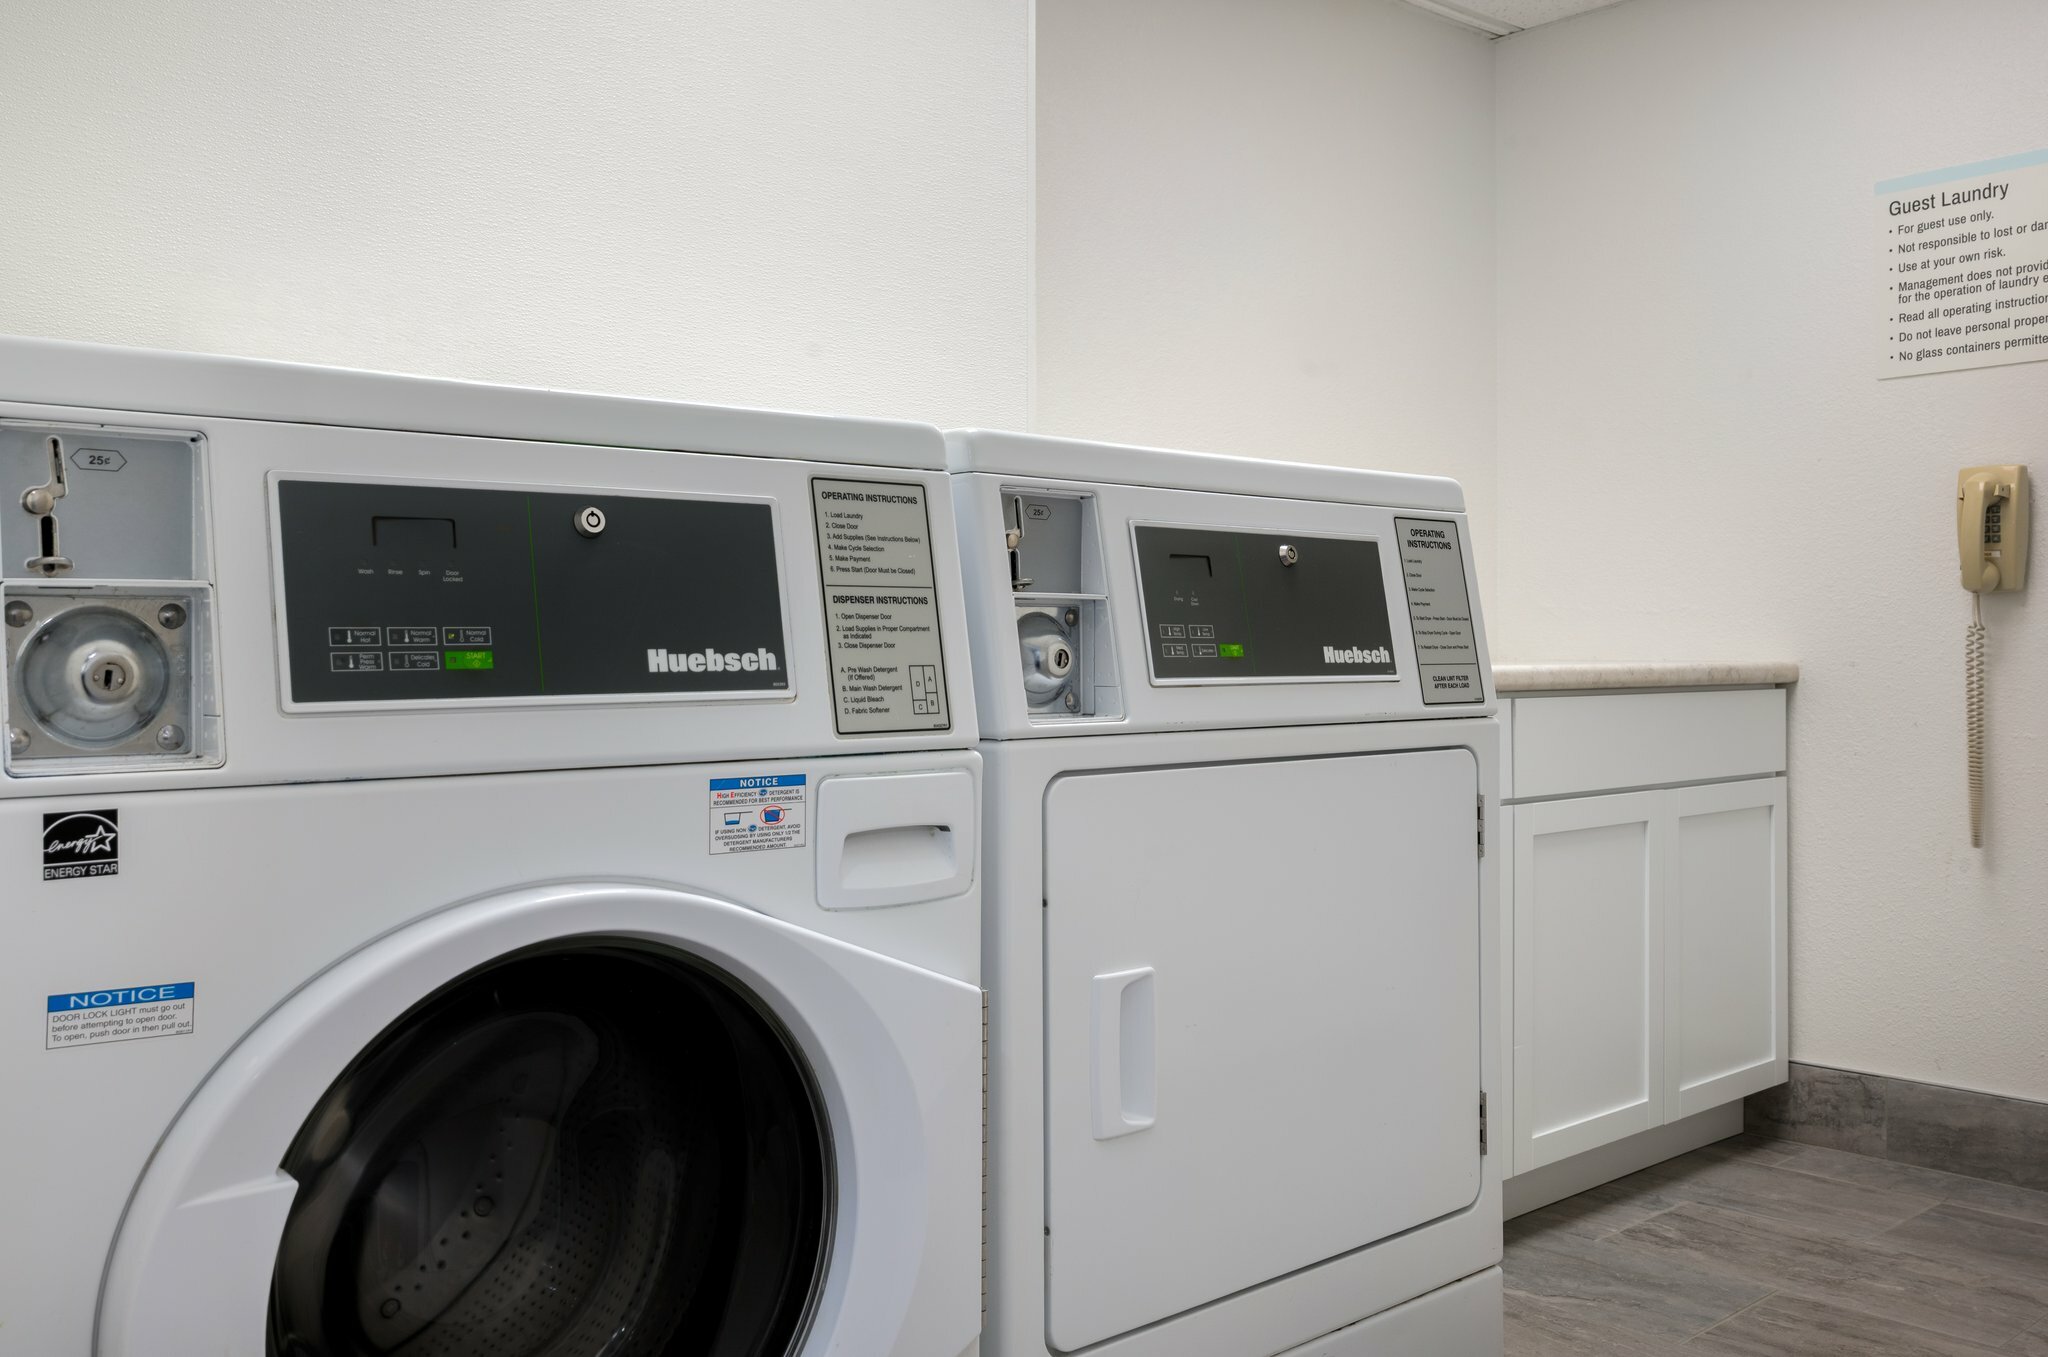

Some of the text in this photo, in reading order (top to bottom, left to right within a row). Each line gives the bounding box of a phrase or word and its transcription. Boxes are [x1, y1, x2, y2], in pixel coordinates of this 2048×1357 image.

[1889, 183, 2009, 215] Guest Laundry
[1898, 210, 1994, 234] For guest use only.
[1899, 225, 2027, 253] Not responsible to lost or
[1899, 247, 2006, 272] Use at your own risk.
[1899, 274, 1963, 291] Management
[1967, 271, 1992, 281] does
[1996, 266, 2012, 276] not
[1898, 274, 2039, 304] for the operation of laundry
[1899, 311, 1924, 322] Read
[1928, 308, 1939, 319] all
[1943, 302, 1992, 318] operating
[1899, 332, 1912, 342] Do
[1916, 329, 1931, 340] not
[1935, 327, 1961, 337] leave
[1966, 318, 2010, 335] personal
[1900, 351, 1912, 360] No
[1916, 348, 1942, 361] glass
[1946, 340, 2000, 355] containers
[89, 454, 111, 466] 25¢
[822, 491, 917, 504] OPERATING INSTRUCTIONS
[1410, 529, 1445, 538] OPERATING
[1407, 540, 1451, 550] INSTRUCTIONS
[833, 595, 928, 604] DISPENSER INSTRUCTIONS
[647, 648, 777, 673] Huebsch
[1323, 646, 1390, 663] Huebsch
[874, 666, 897, 674] Detergent
[740, 778, 778, 787] NOTICE
[45, 864, 117, 879] ENERGY STAR
[70, 986, 175, 1008] NOTICE
[53, 1014, 80, 1022] DOOR
[83, 1011, 108, 1020] LOCK
[110, 1008, 136, 1016] LIGHT
[140, 1005, 158, 1014] must
[161, 1004, 170, 1012] go
[52, 1024, 78, 1032] before
[81, 1019, 123, 1030] attempting
[90, 1030, 109, 1039] push
[162, 1022, 175, 1031] pull
